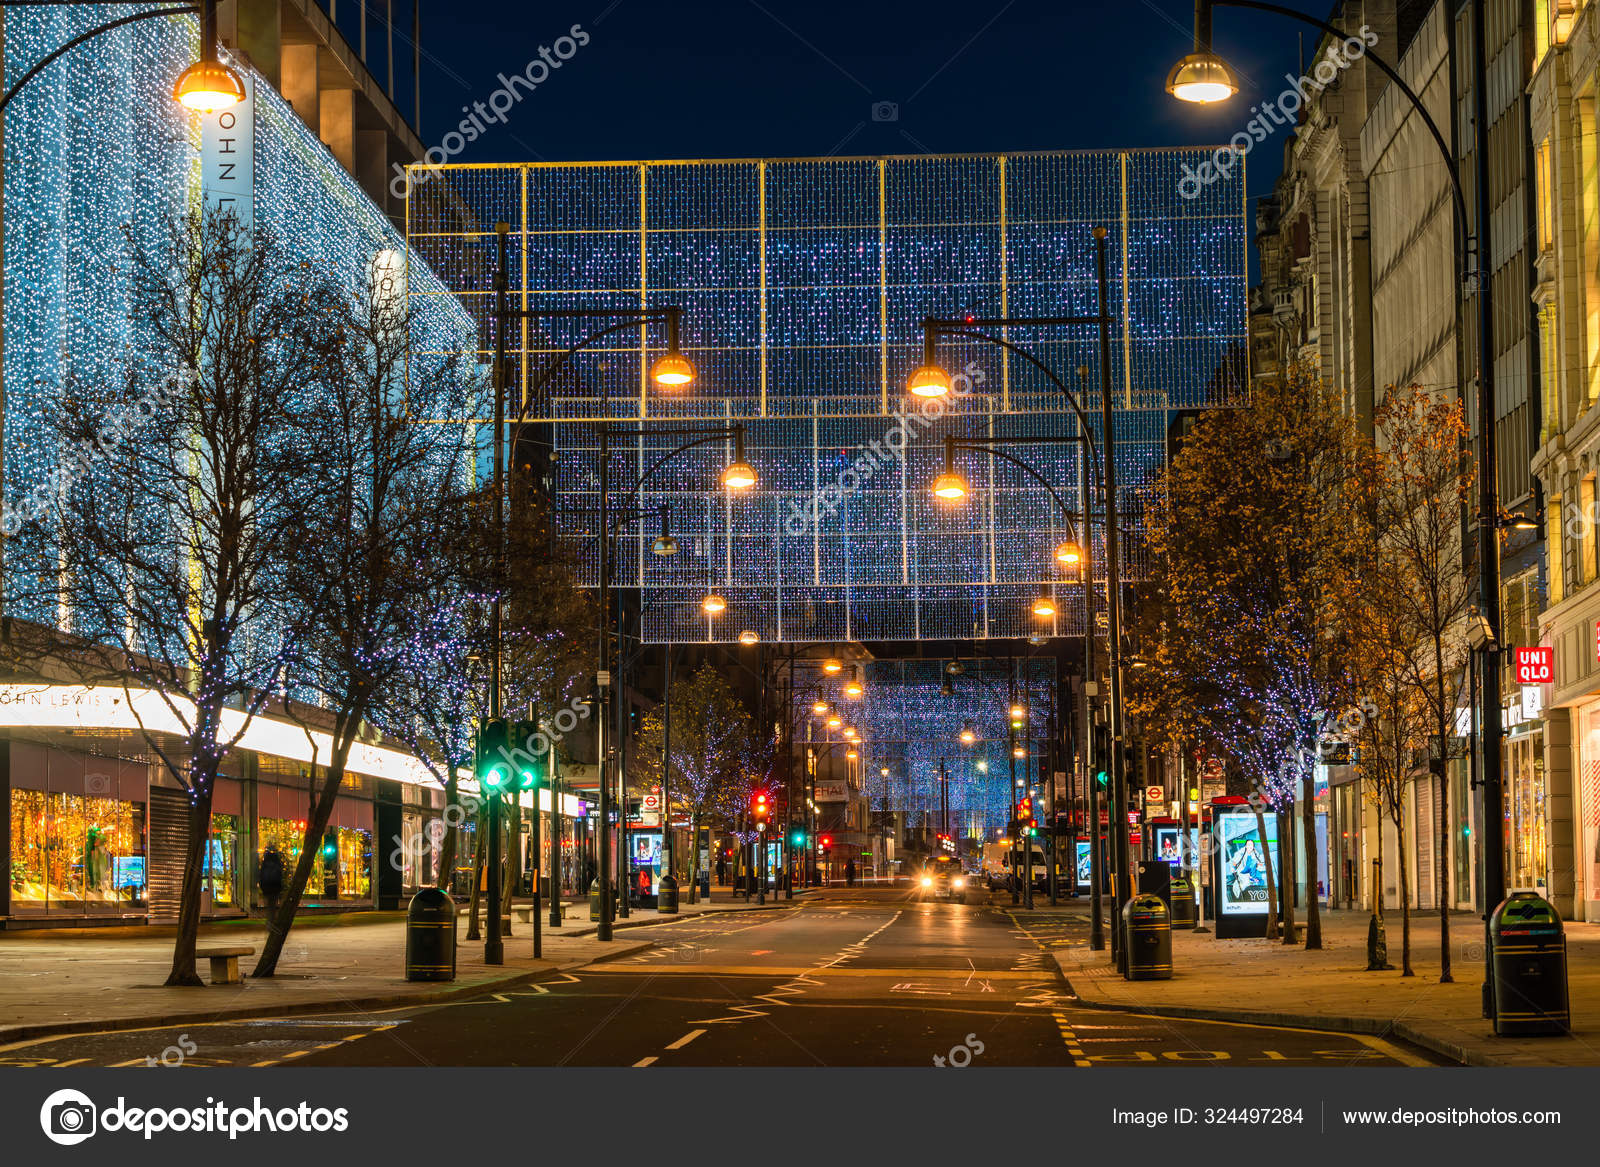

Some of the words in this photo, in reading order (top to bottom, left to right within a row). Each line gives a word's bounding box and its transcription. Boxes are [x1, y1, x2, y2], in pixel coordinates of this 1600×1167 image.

[218, 111, 236, 180] OHN
[1520, 651, 1546, 664] UNI
[1520, 666, 1549, 680] QLO
[0, 693, 41, 705] OHN
